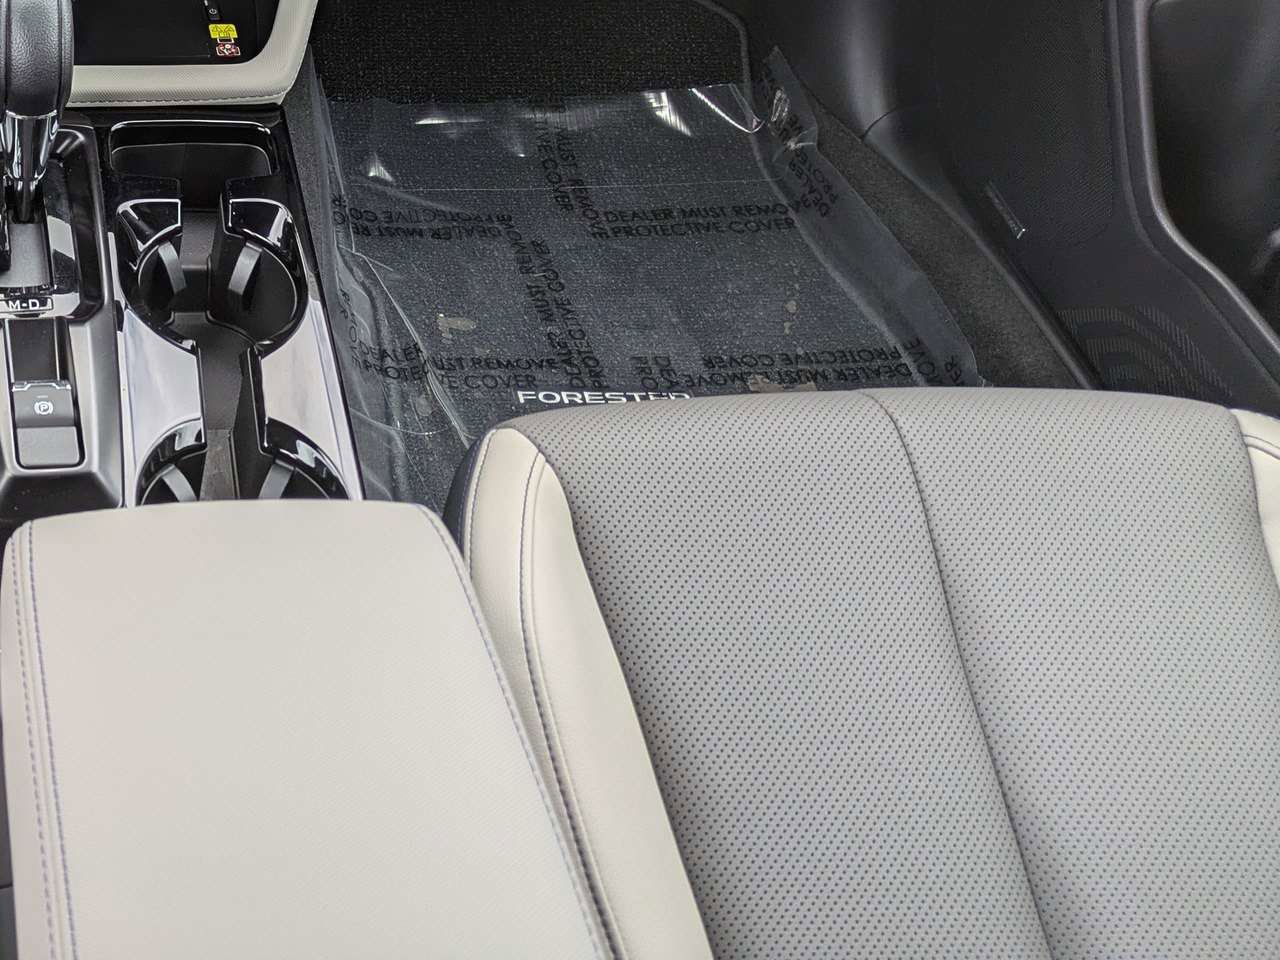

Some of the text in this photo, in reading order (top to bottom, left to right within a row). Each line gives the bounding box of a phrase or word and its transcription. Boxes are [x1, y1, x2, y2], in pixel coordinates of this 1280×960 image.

[540, 157, 574, 212] COVER
[570, 178, 610, 240] REMOVE
[604, 194, 812, 223] DEALER MUST REMOVE
[378, 225, 424, 238] MUST
[612, 216, 795, 238] PROTECTIVE COVER
[531, 239, 565, 292] COVER
[472, 357, 557, 370] REMOVE
[702, 346, 902, 369] PROTECTIVE COVER
[464, 374, 537, 390] COVER
[833, 363, 912, 383] DEALER
